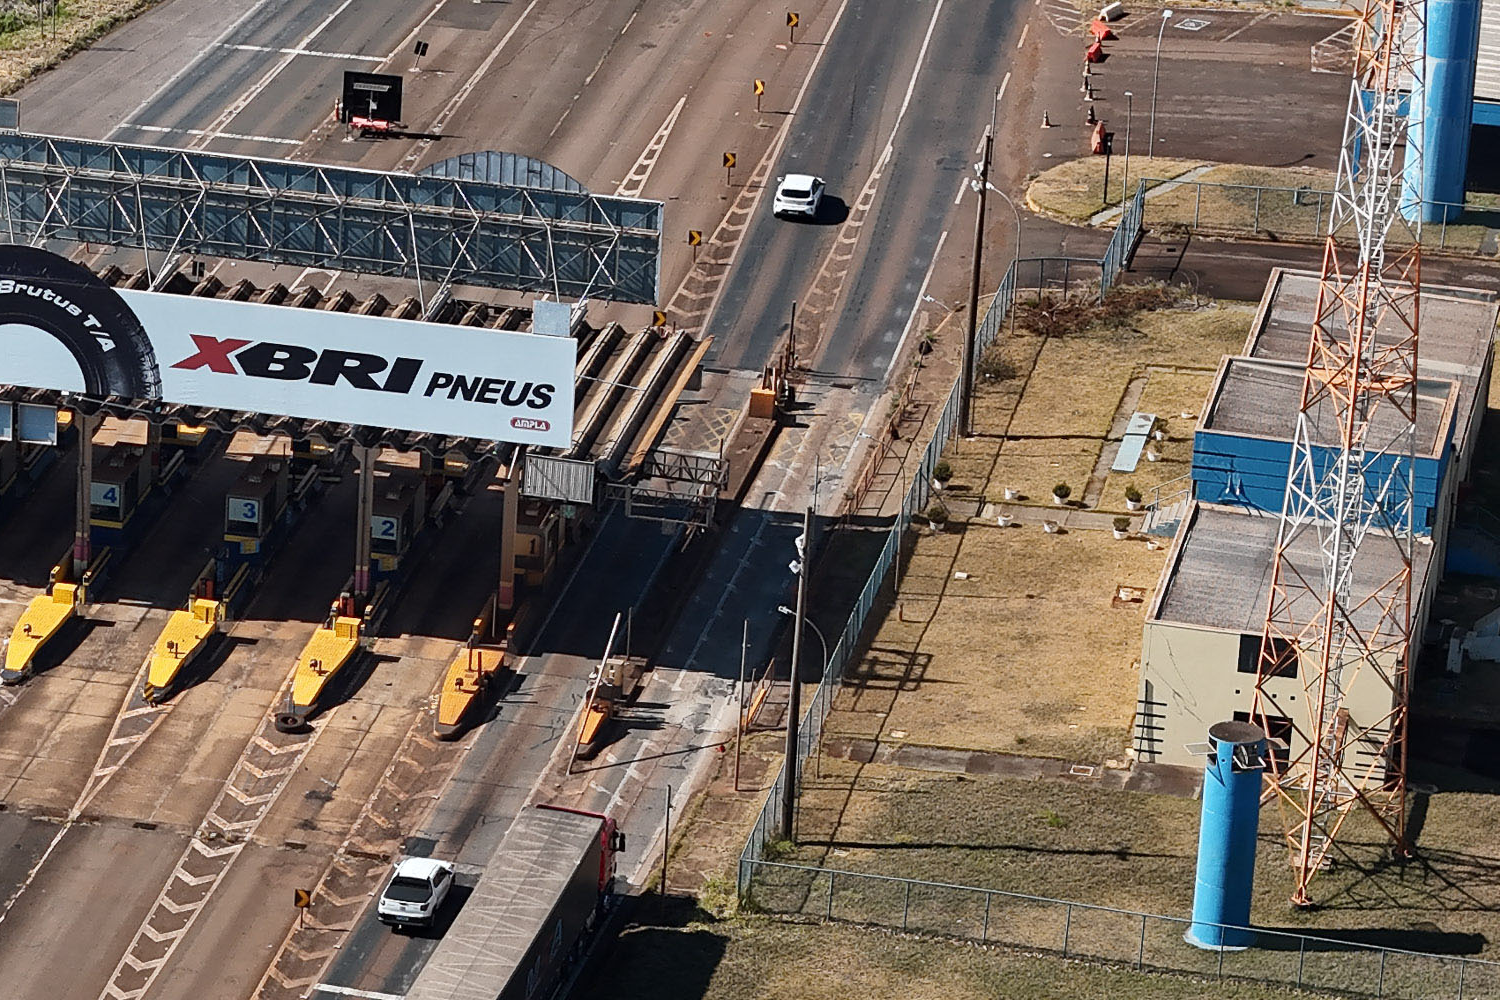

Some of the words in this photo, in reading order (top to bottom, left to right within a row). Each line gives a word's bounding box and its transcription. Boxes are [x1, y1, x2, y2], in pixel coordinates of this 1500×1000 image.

[83, 313, 116, 353] T/A
[169, 333, 424, 394] XBRI
[424, 371, 556, 409] PNEUS
[514, 418, 547, 430] AMPLA
[102, 487, 117, 503] 4
[243, 502, 256, 519] 3
[381, 519, 395, 536] 2
